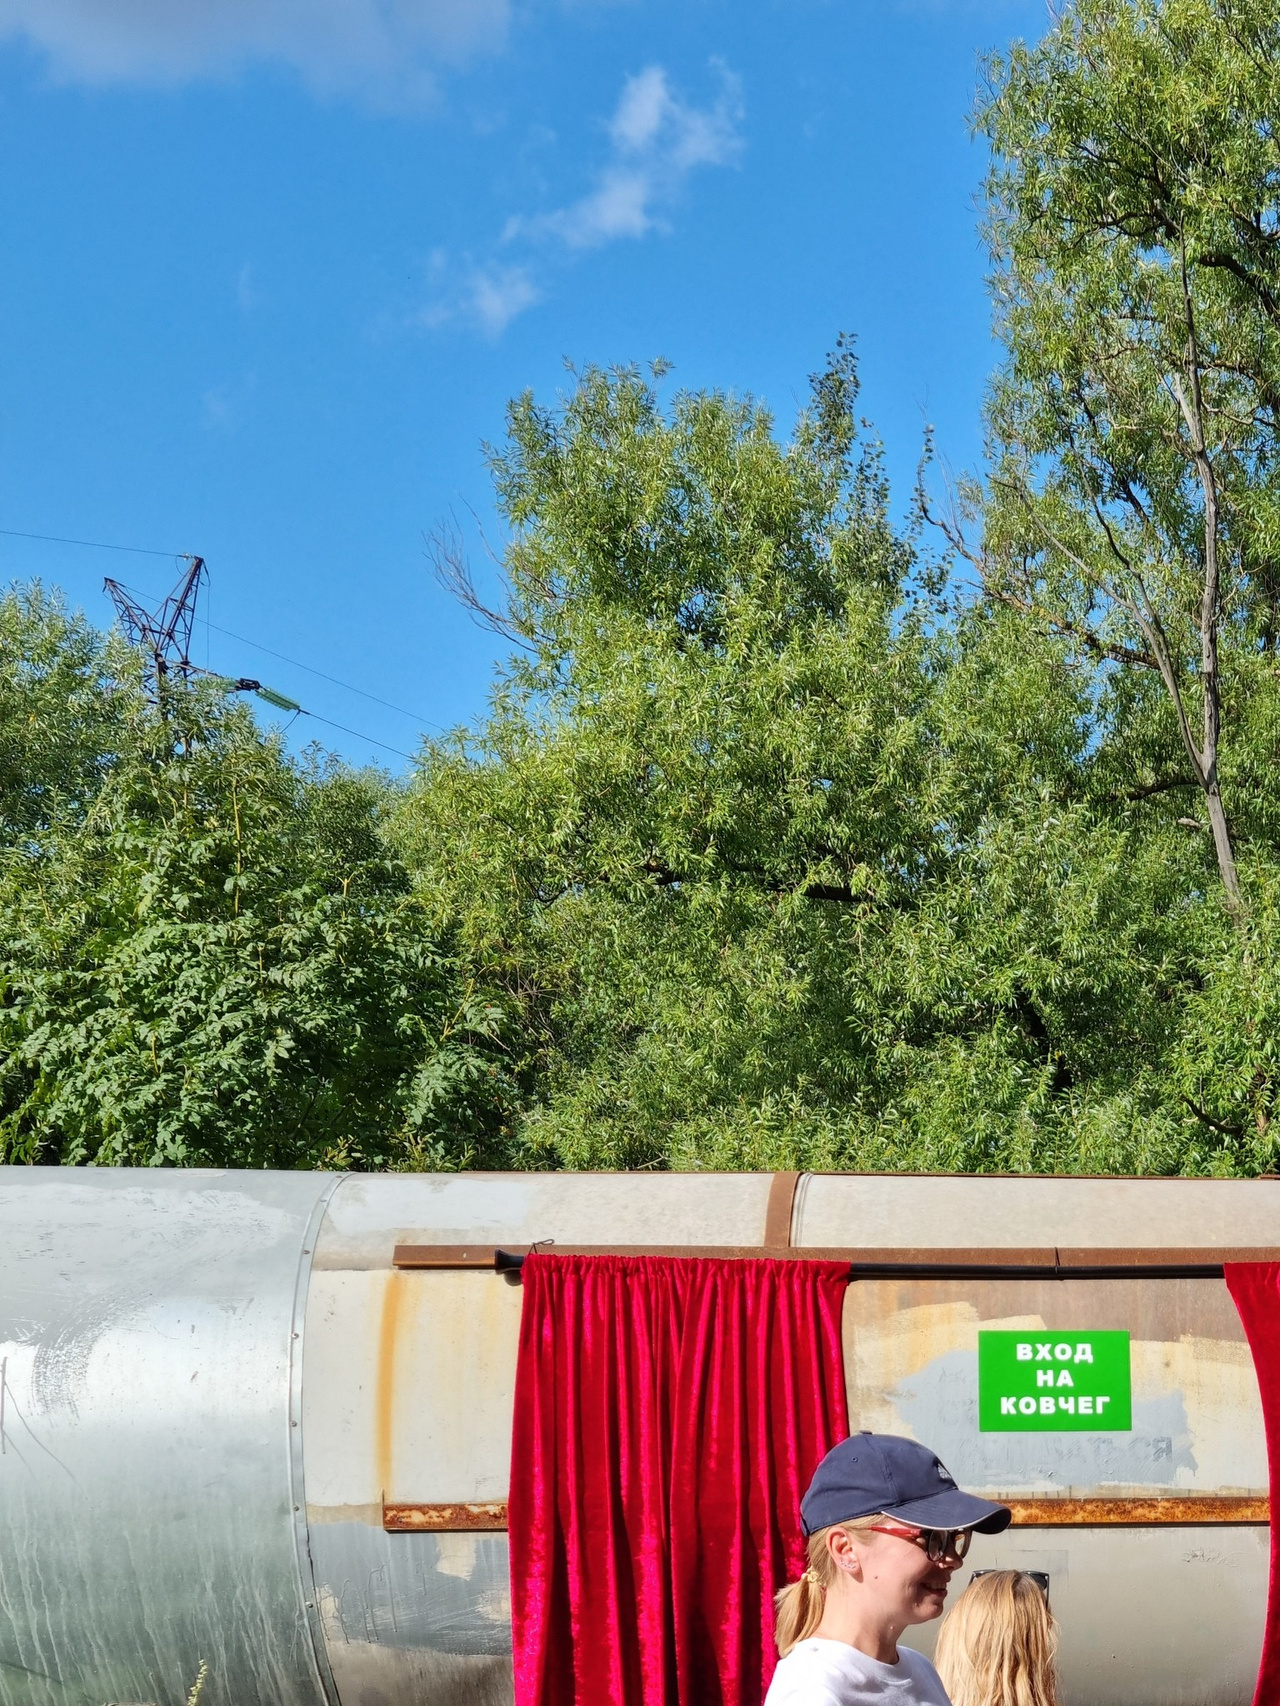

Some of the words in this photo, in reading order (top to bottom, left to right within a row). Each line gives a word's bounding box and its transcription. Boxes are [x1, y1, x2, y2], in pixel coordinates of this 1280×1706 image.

[1016, 1343, 1094, 1364] ВХОД
[1036, 1369, 1074, 1388] НА
[1000, 1396, 1111, 1415] КОВЧЕГ
